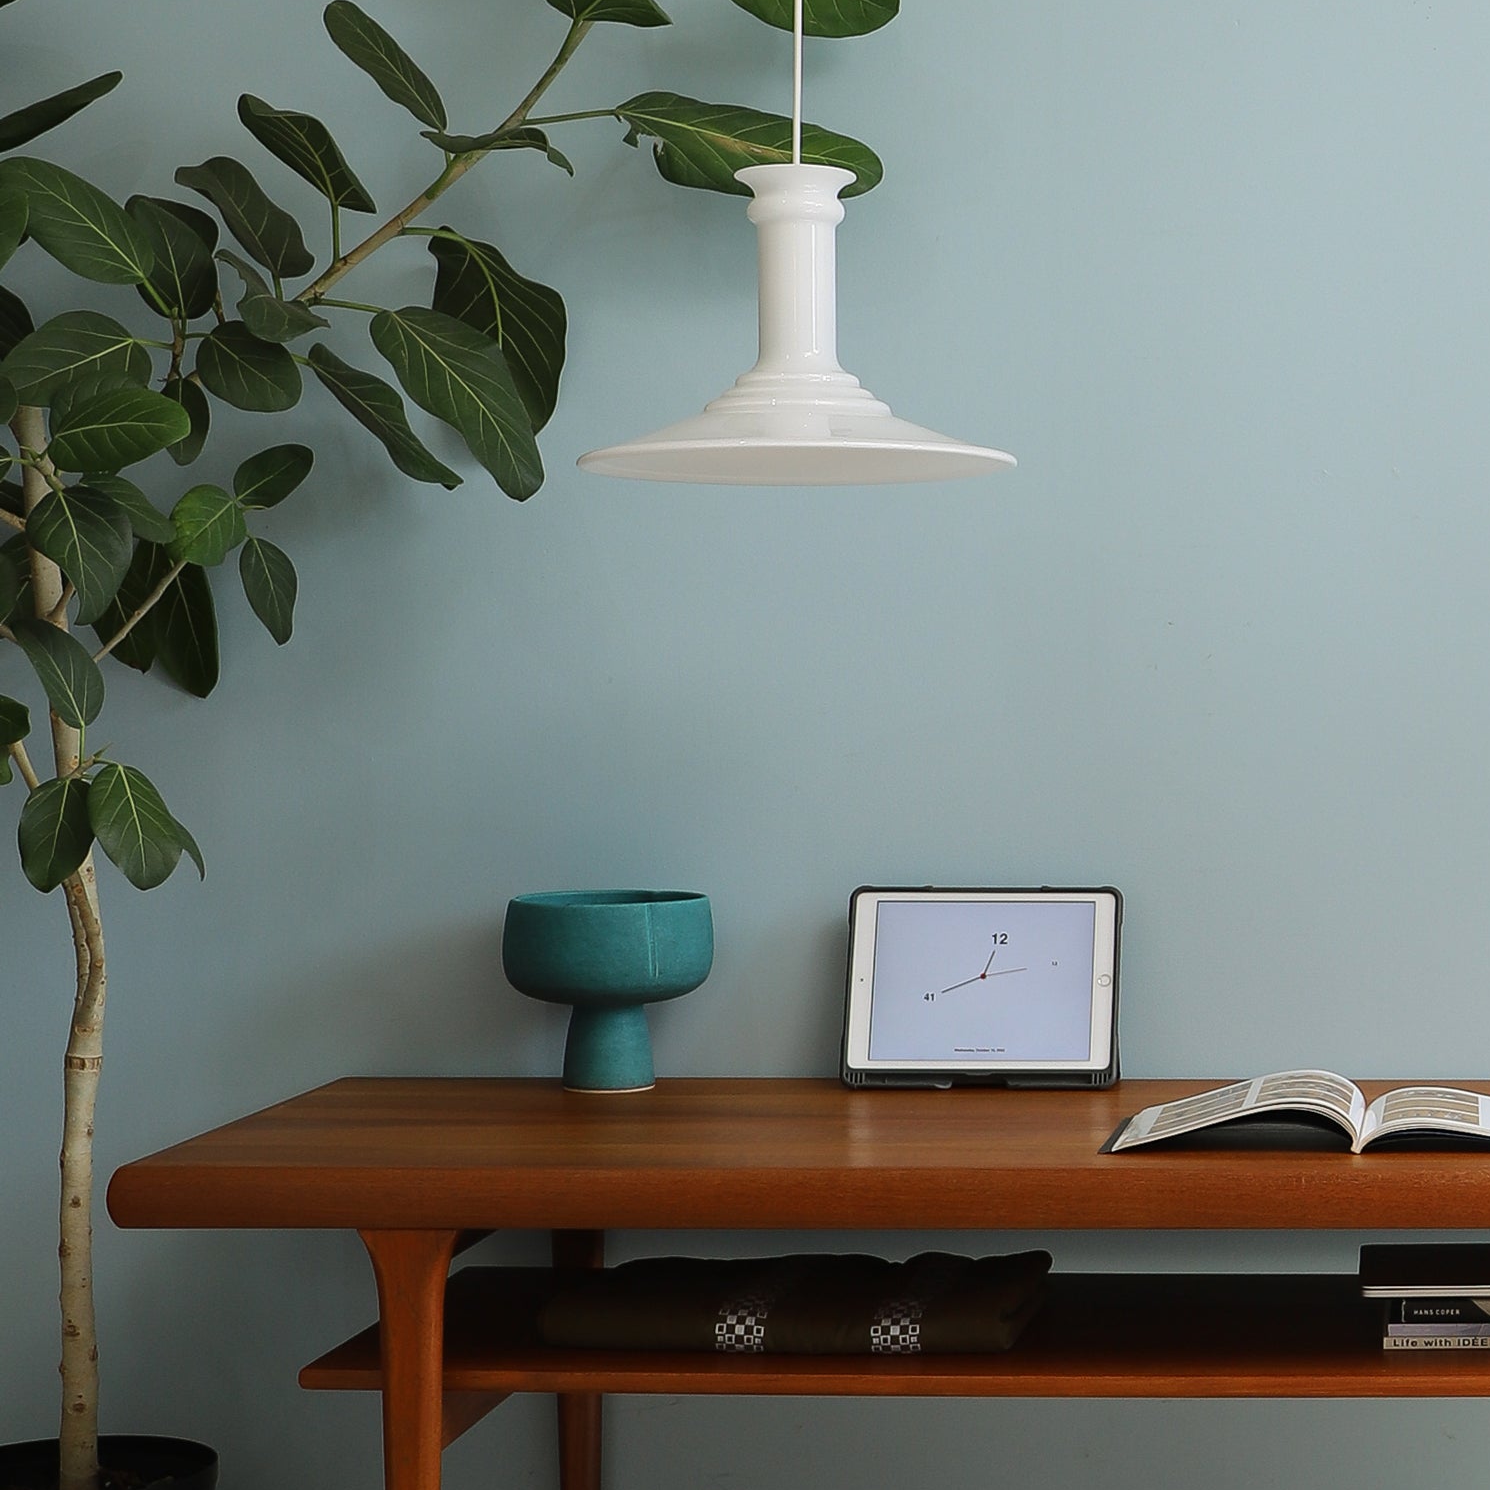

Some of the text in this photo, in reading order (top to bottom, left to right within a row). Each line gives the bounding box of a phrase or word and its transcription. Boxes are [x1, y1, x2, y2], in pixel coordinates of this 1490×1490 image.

[991, 932, 1008, 945] 12
[923, 992, 935, 1002] 41
[1413, 1308, 1460, 1316] HANS COPER
[1393, 1337, 1418, 1347] Life
[1423, 1337, 1452, 1347] with
[1457, 1336, 1489, 1347] IDÉE
